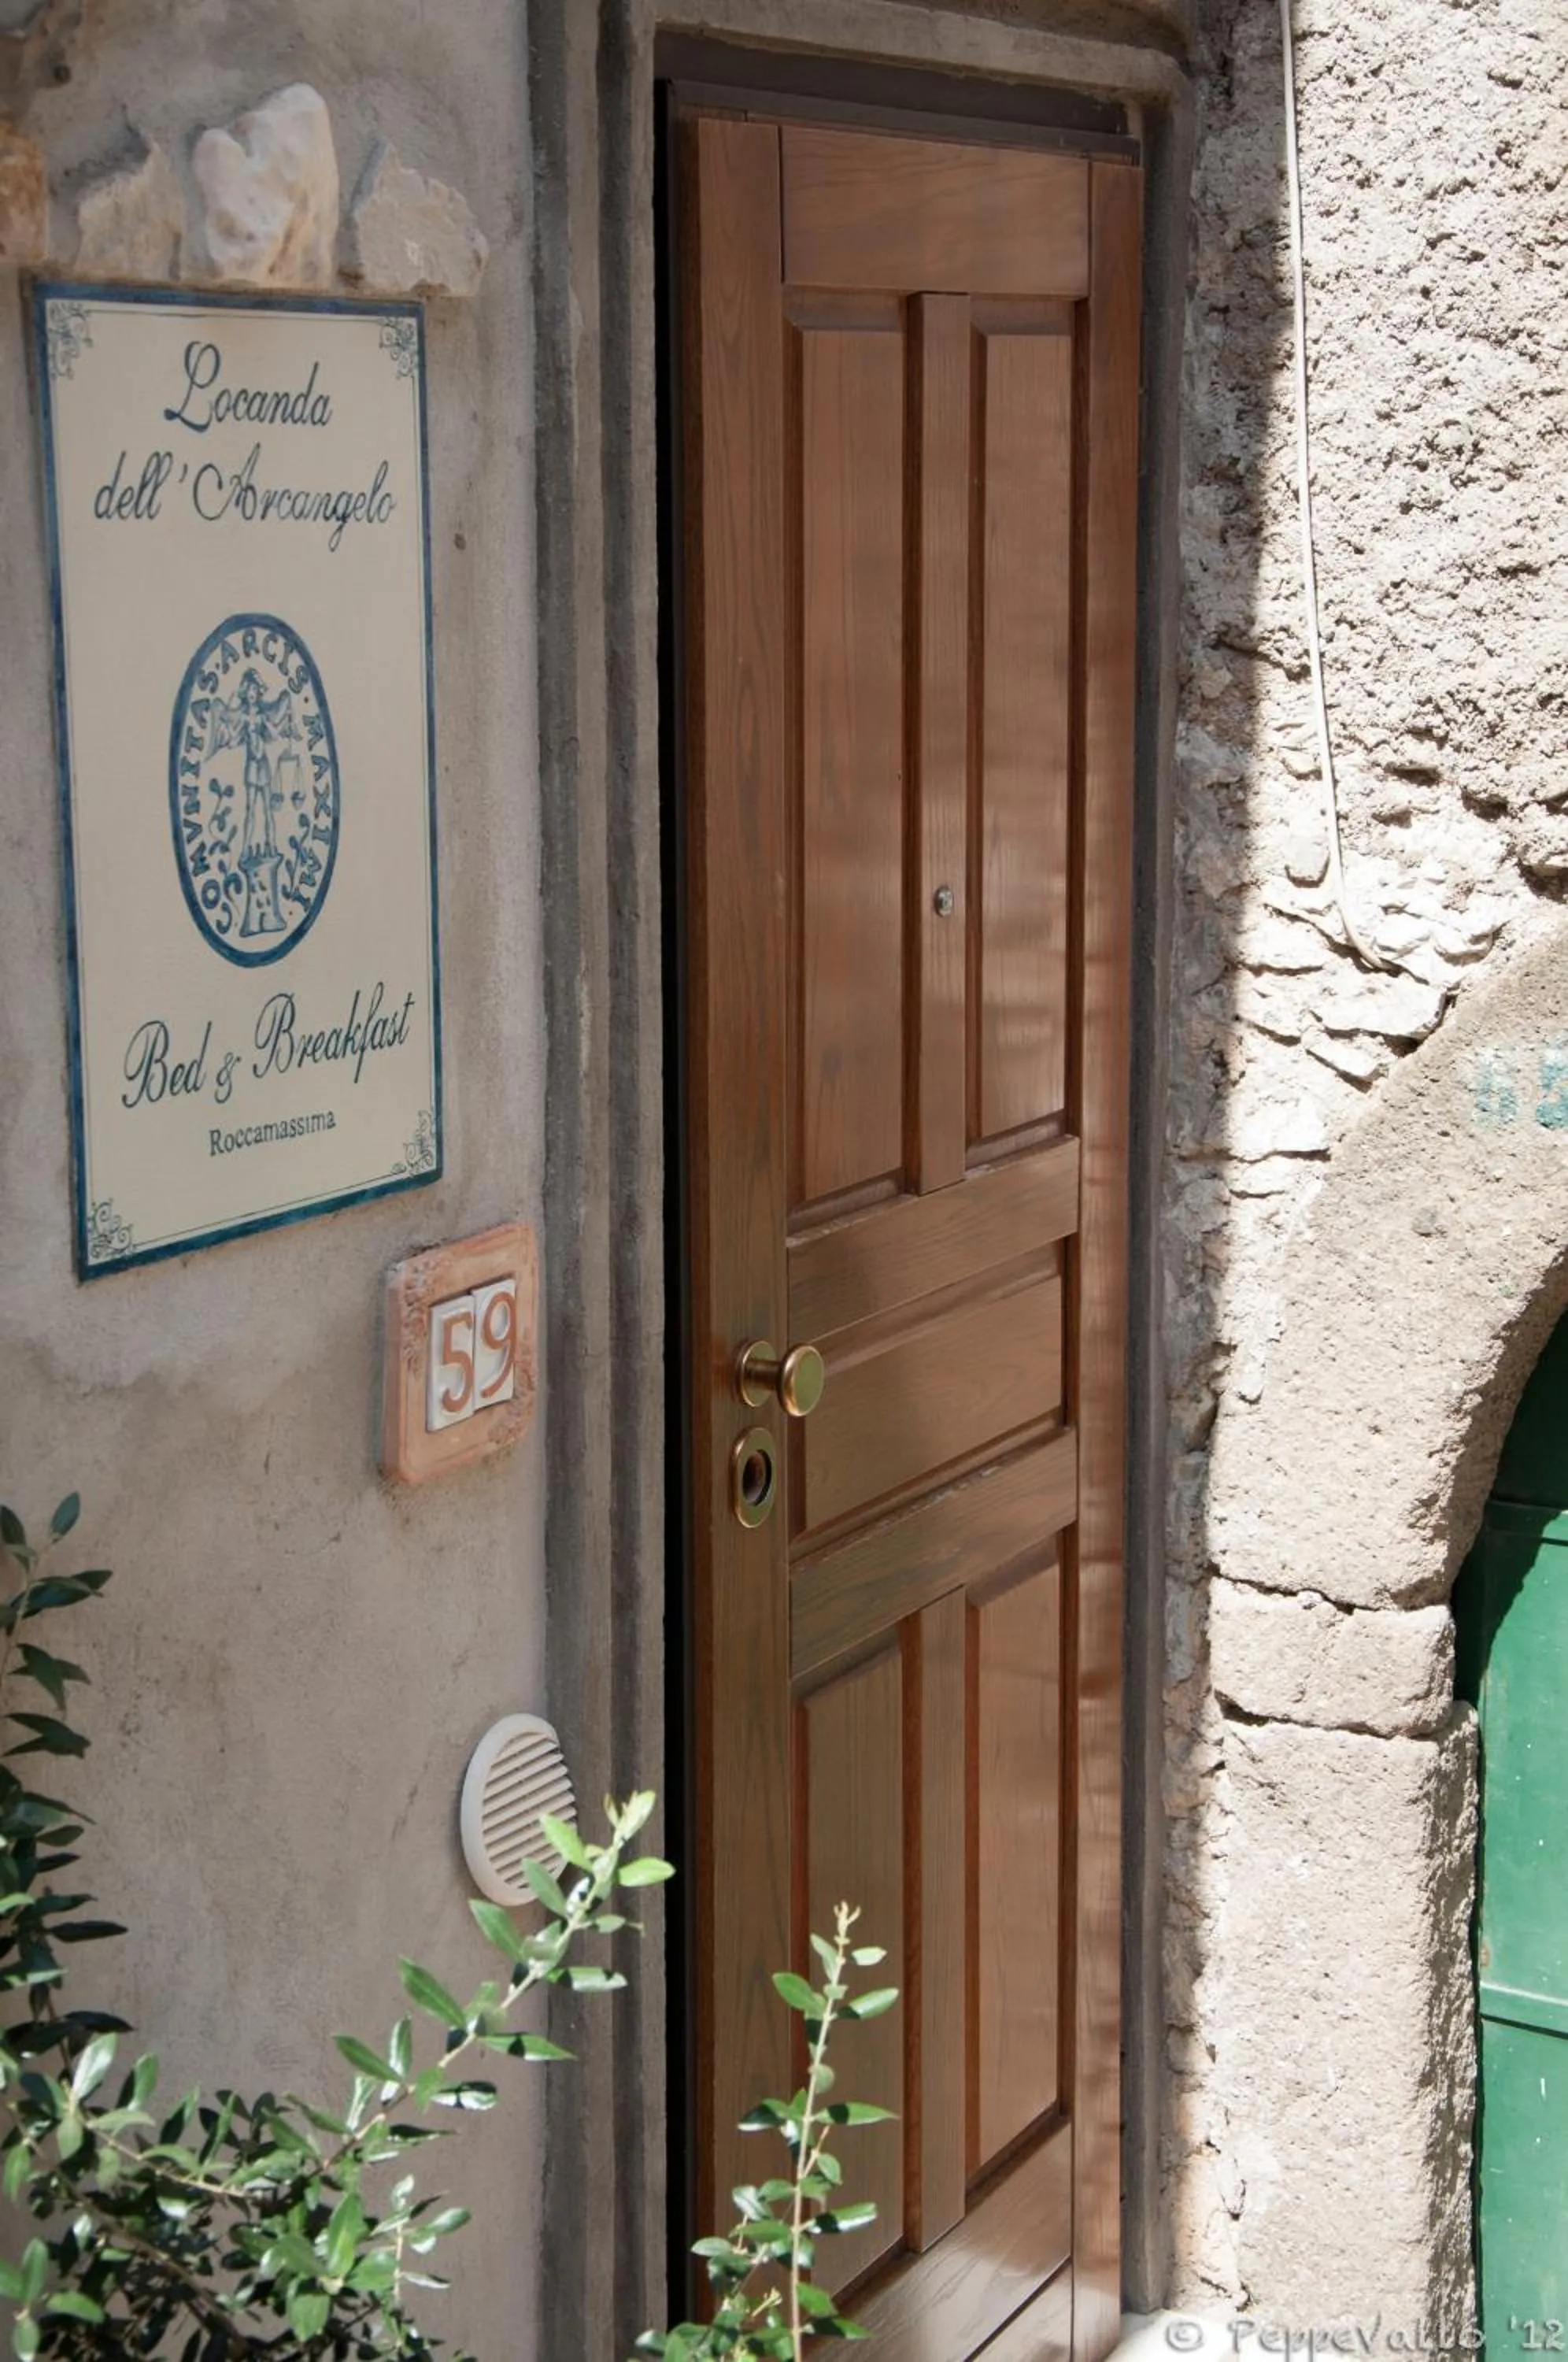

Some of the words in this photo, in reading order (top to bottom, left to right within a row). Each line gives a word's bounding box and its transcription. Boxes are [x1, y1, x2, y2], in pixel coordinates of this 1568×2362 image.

[163, 340, 334, 433] Locanda
[120, 1020, 213, 1109] Bed
[214, 1051, 242, 1104] &
[252, 981, 416, 1084] Breakfast
[208, 1109, 336, 1157] Roccamassima
[441, 1290, 517, 1413] 59
